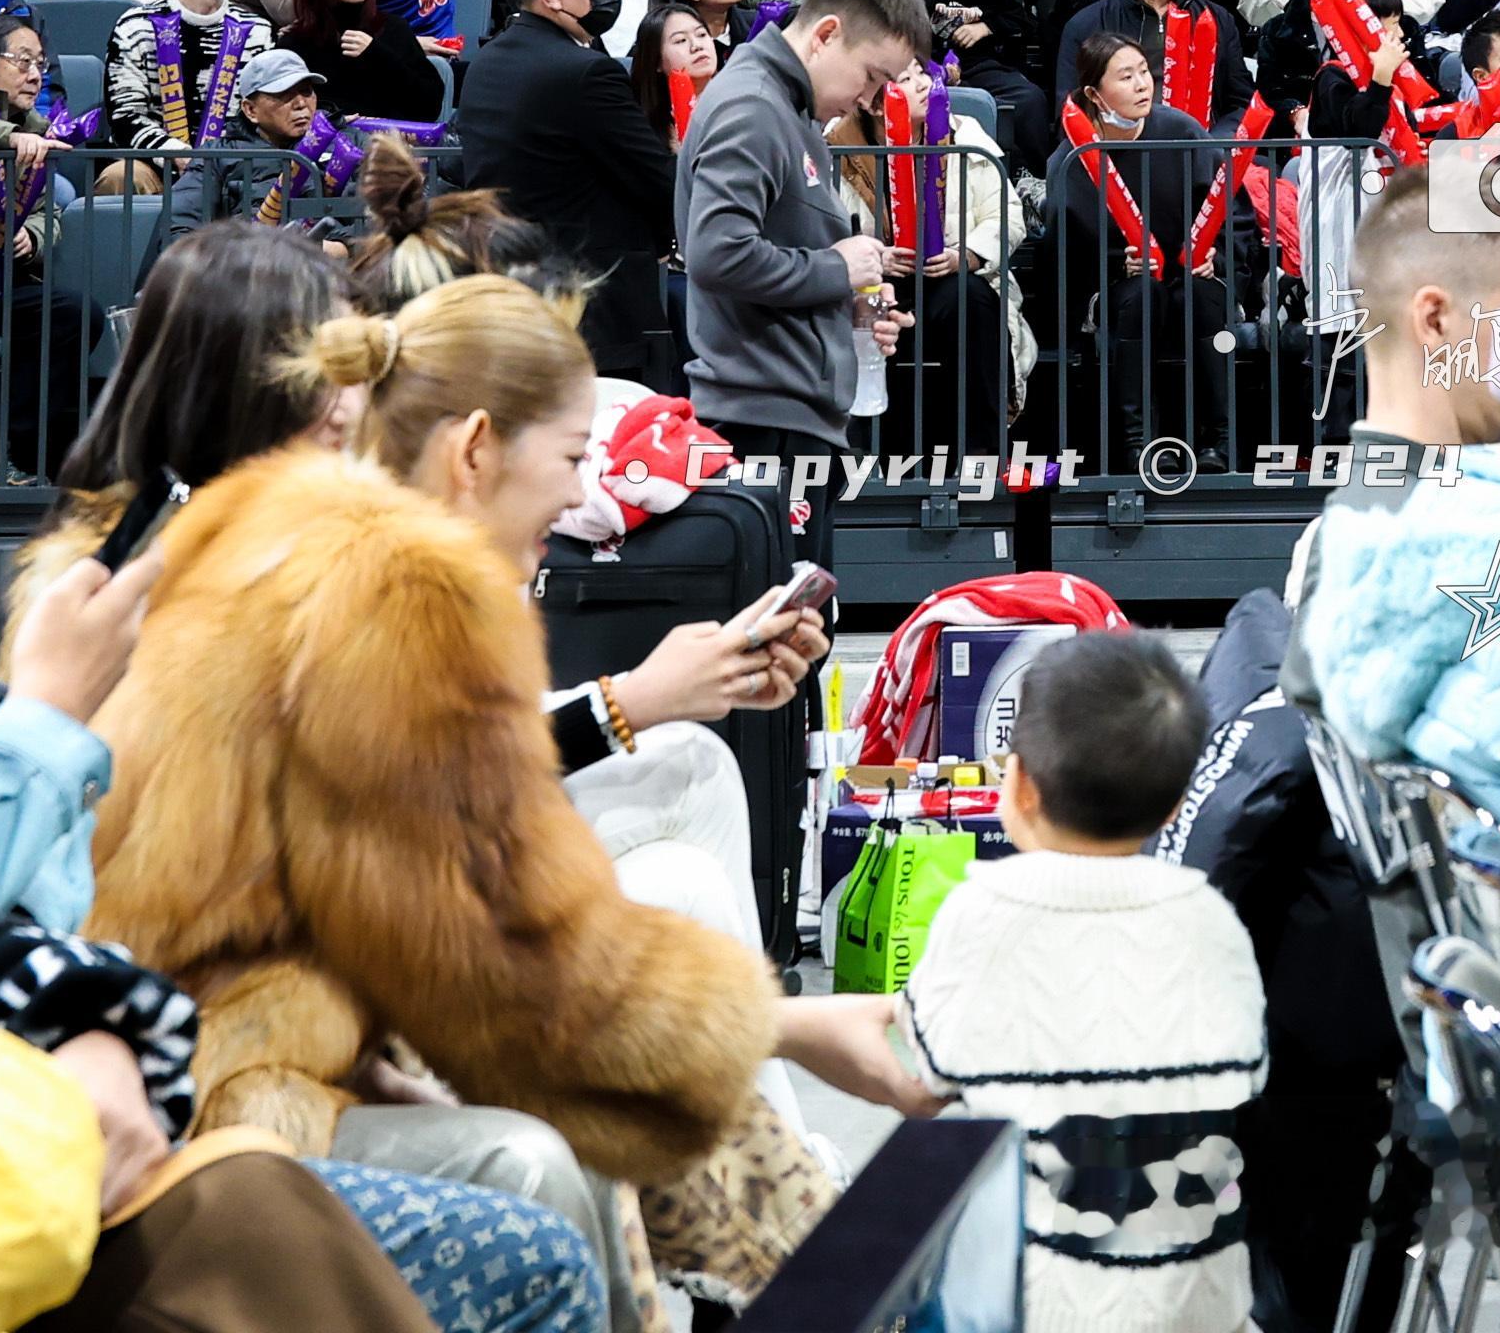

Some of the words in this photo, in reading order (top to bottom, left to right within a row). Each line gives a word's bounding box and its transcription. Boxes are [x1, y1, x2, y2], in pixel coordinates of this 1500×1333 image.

[1170, 718, 1257, 868] WINDSTOPPE
[895, 846, 916, 908] TOUS
[891, 935, 912, 995] JOUR
